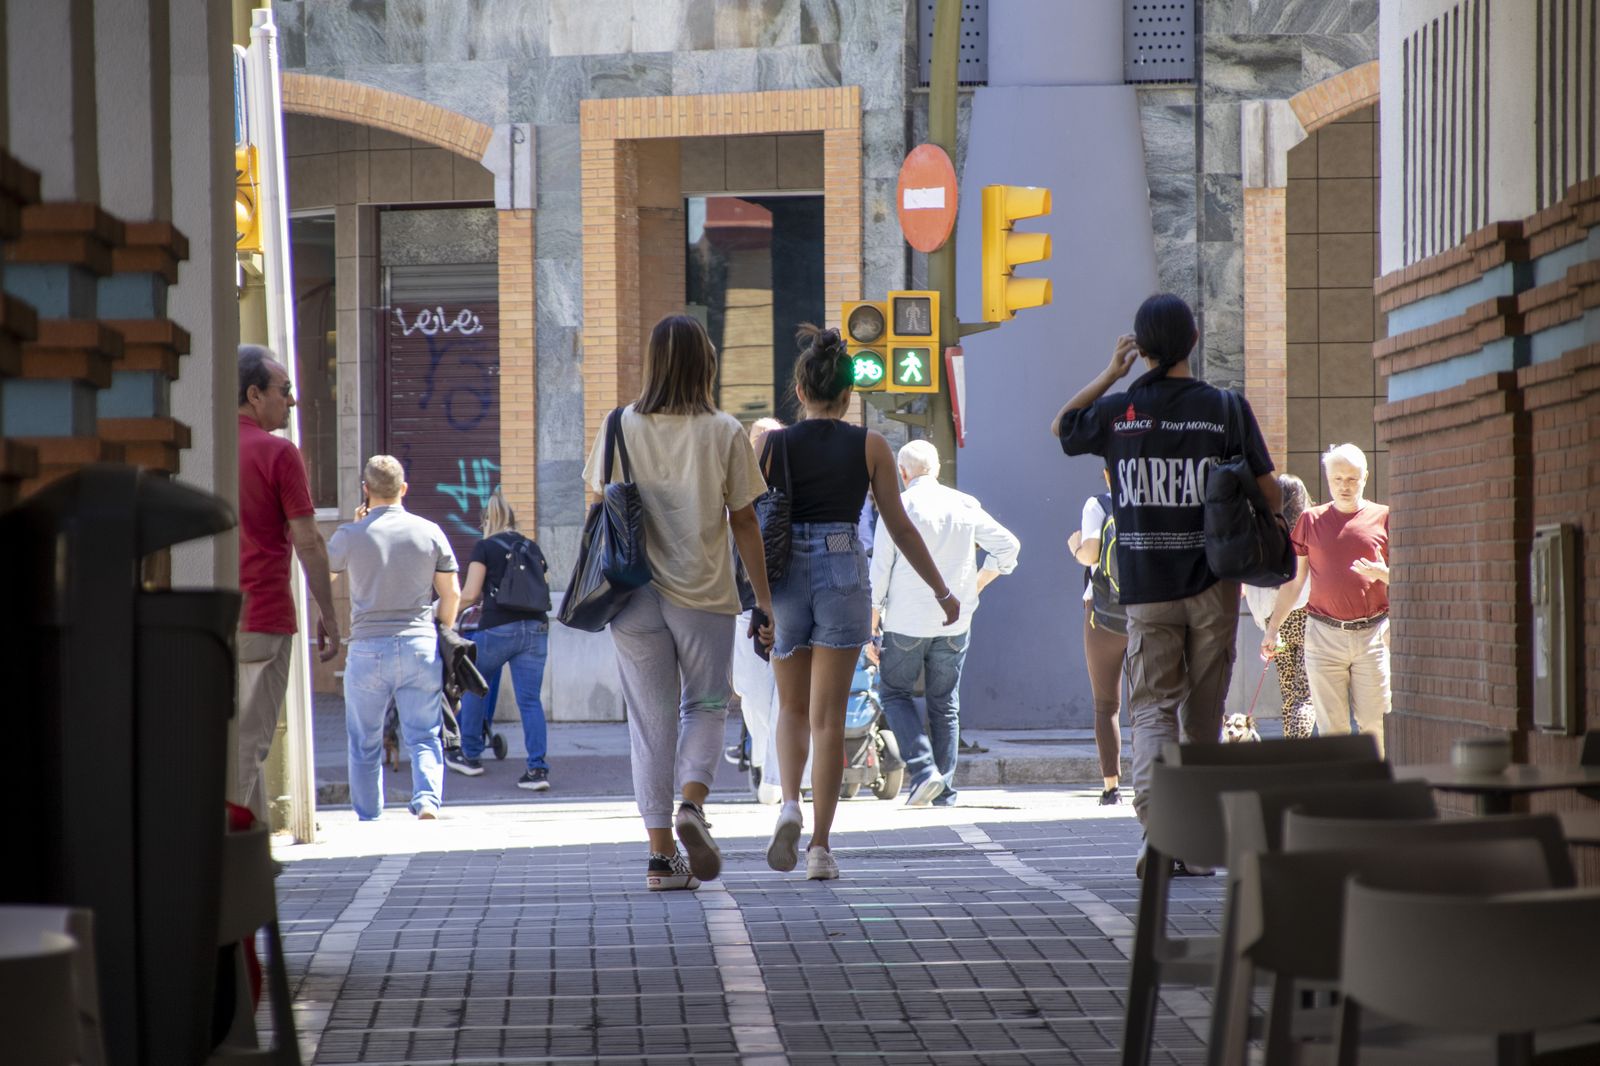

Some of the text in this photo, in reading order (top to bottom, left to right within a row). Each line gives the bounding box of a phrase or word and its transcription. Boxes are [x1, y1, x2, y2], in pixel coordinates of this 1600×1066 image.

[1113, 419, 1153, 432] SCARFACE
[1160, 420, 1225, 433] TONY MONTAN
[1118, 457, 1220, 508] SCARFAC
